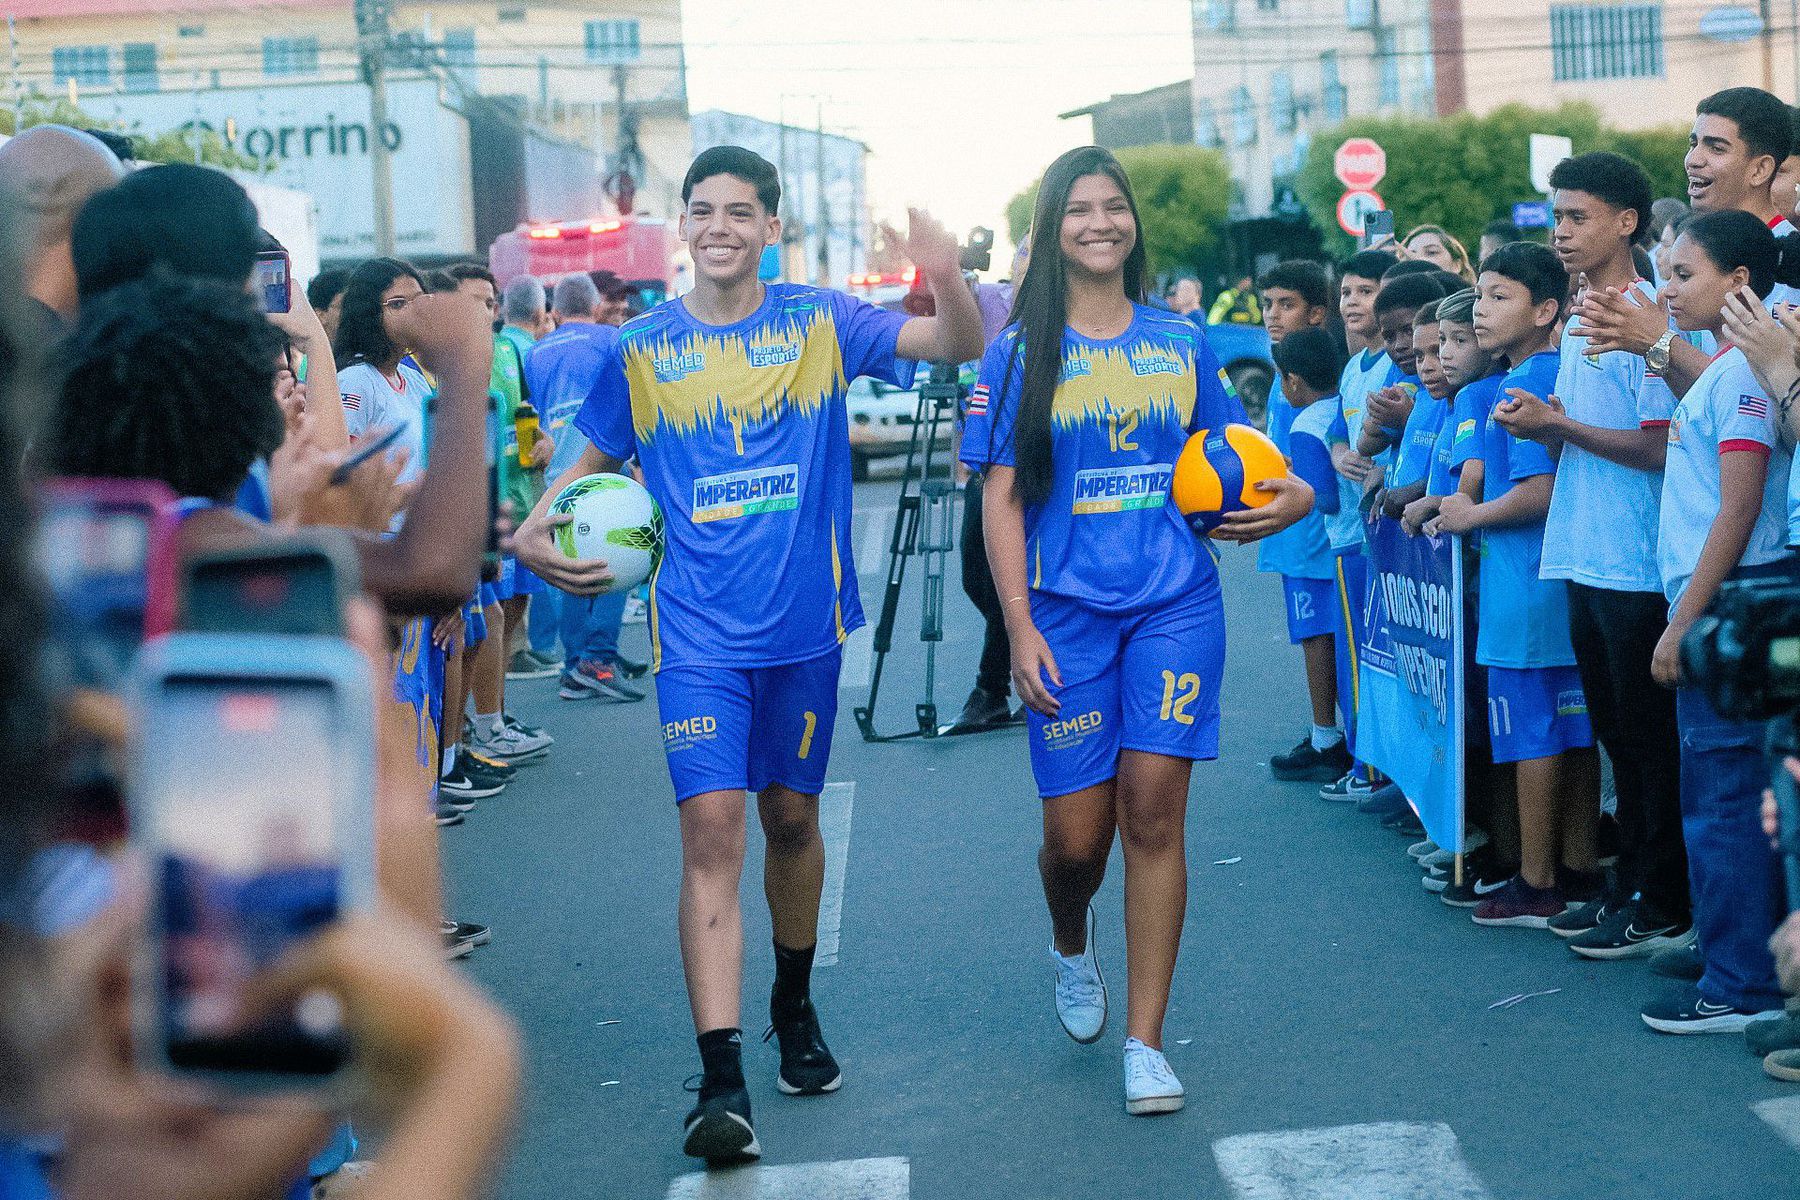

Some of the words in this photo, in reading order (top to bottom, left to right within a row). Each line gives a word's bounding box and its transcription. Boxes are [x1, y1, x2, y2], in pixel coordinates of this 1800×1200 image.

[180, 112, 402, 159] orrino
[652, 353, 705, 373] SEMED
[728, 405, 744, 456] 1
[1106, 404, 1139, 452] 12
[696, 472, 797, 508] IMPERATRIZ
[1076, 472, 1171, 499] IMPERATRIZ
[1292, 591, 1315, 620] 12
[1159, 669, 1200, 725] 12
[1487, 696, 1511, 736] 11
[798, 711, 817, 759] 1
[1042, 711, 1102, 740] SEMED
